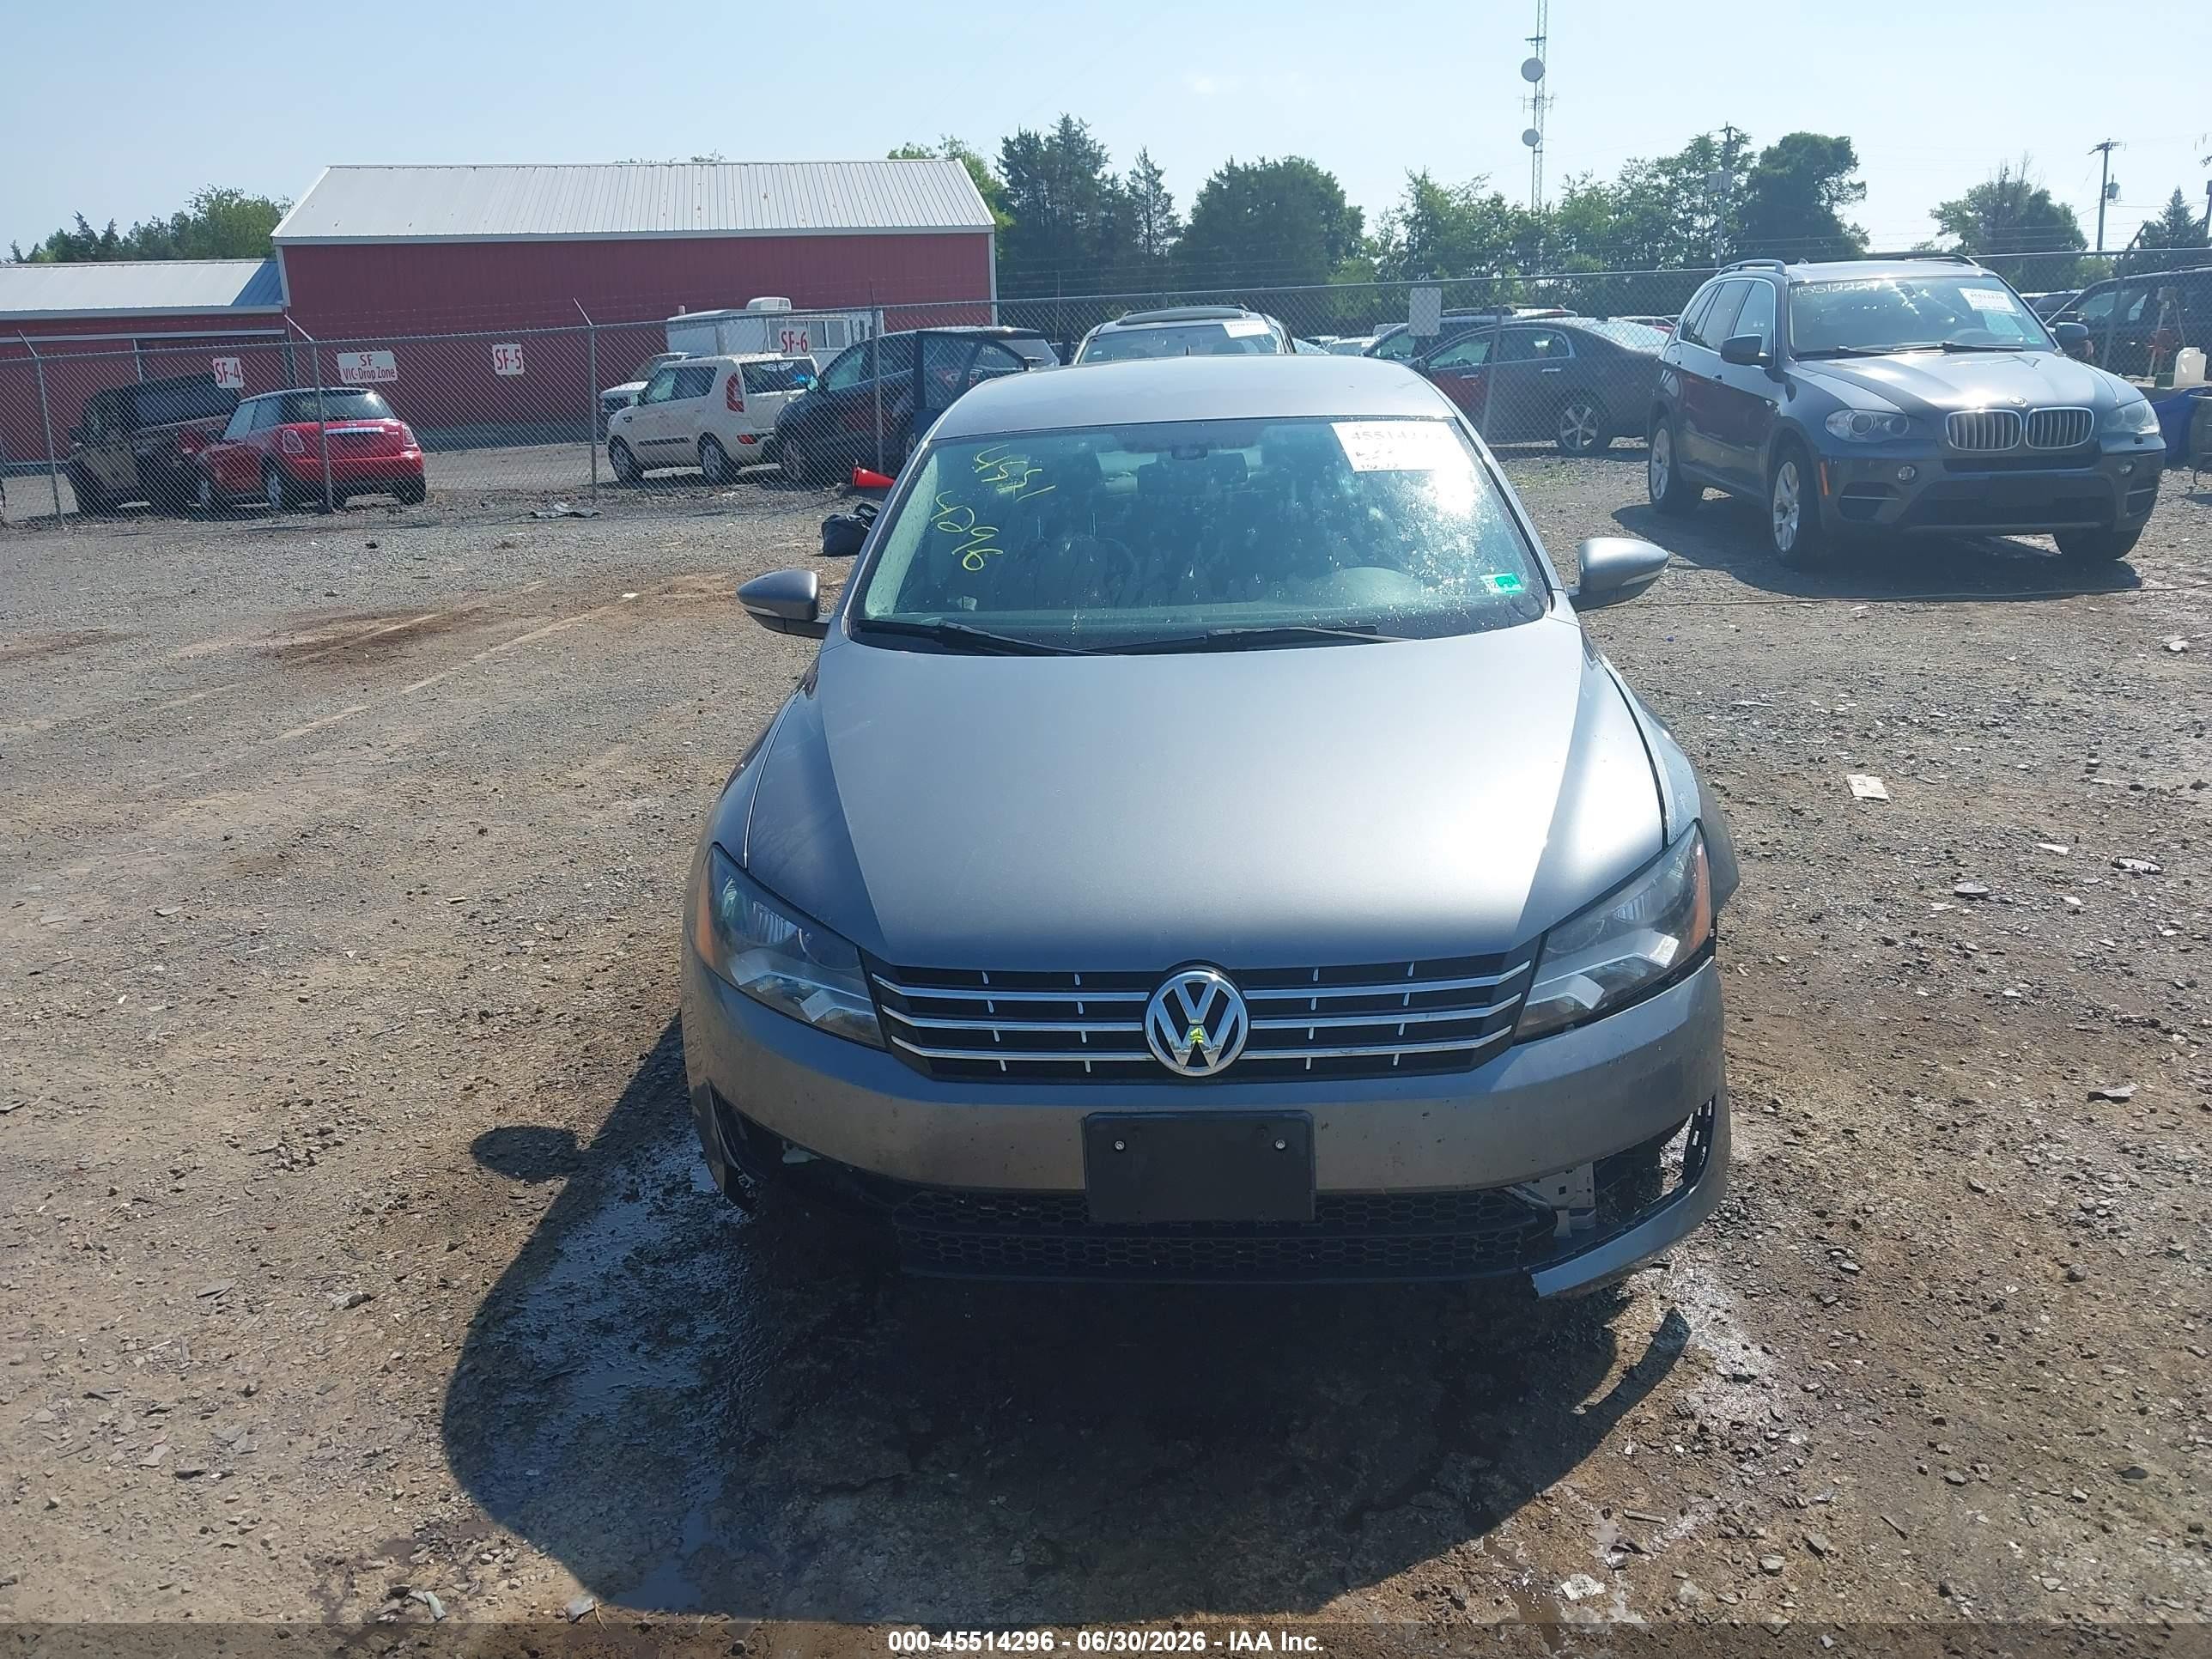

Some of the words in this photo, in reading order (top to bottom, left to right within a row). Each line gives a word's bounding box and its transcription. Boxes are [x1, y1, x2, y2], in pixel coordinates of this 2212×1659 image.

[781, 330, 808, 353] SF-6
[359, 354, 374, 367] SF
[495, 348, 522, 370] SF-5
[215, 362, 241, 384] SF-4
[342, 367, 376, 380] VIC-Drop
[376, 366, 395, 379] Zone
